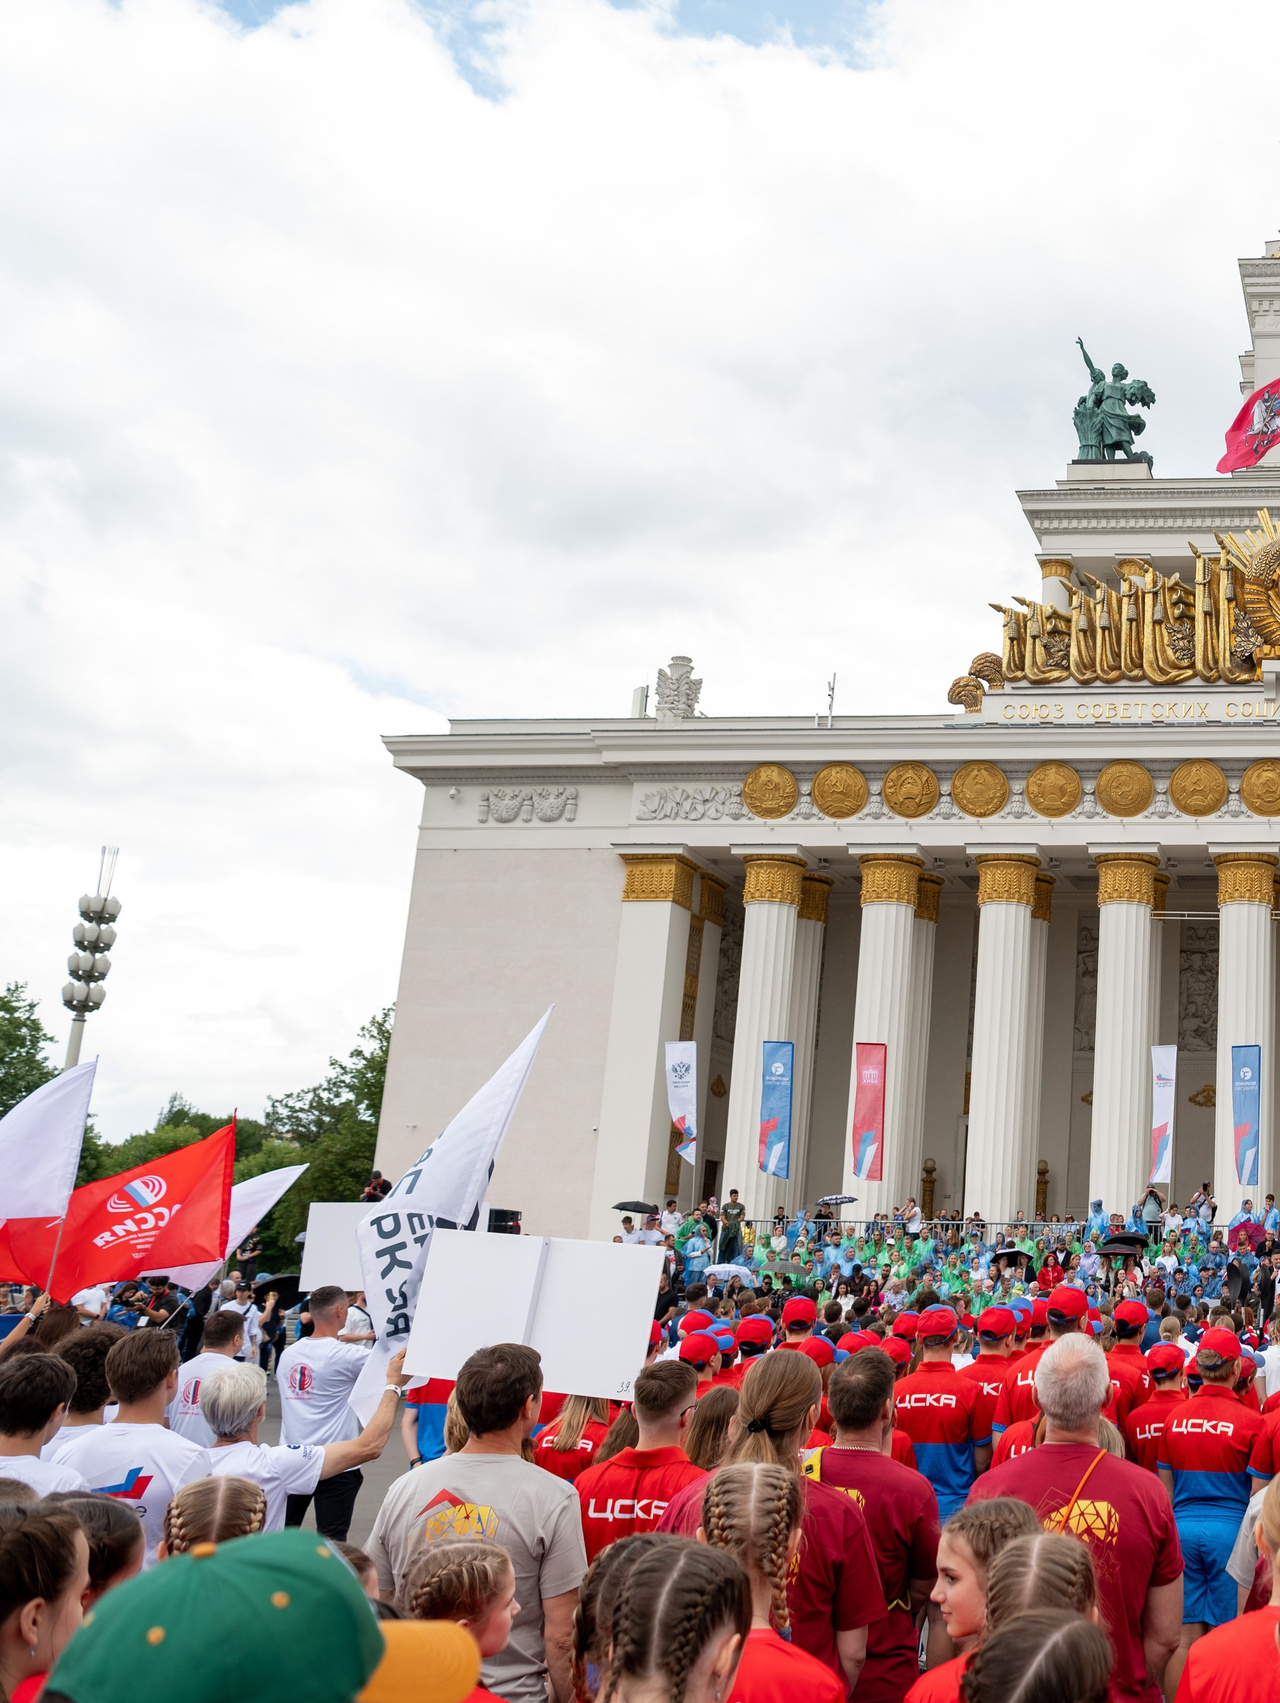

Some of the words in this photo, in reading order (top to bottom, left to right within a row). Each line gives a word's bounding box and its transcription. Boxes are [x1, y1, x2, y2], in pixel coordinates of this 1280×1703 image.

[1002, 702, 1065, 719] СОЮЗ
[1076, 702, 1209, 719] СОВЕТСКИХ
[896, 1393, 957, 1409] ЦСКА
[1172, 1418, 1234, 1437] ЦСКА
